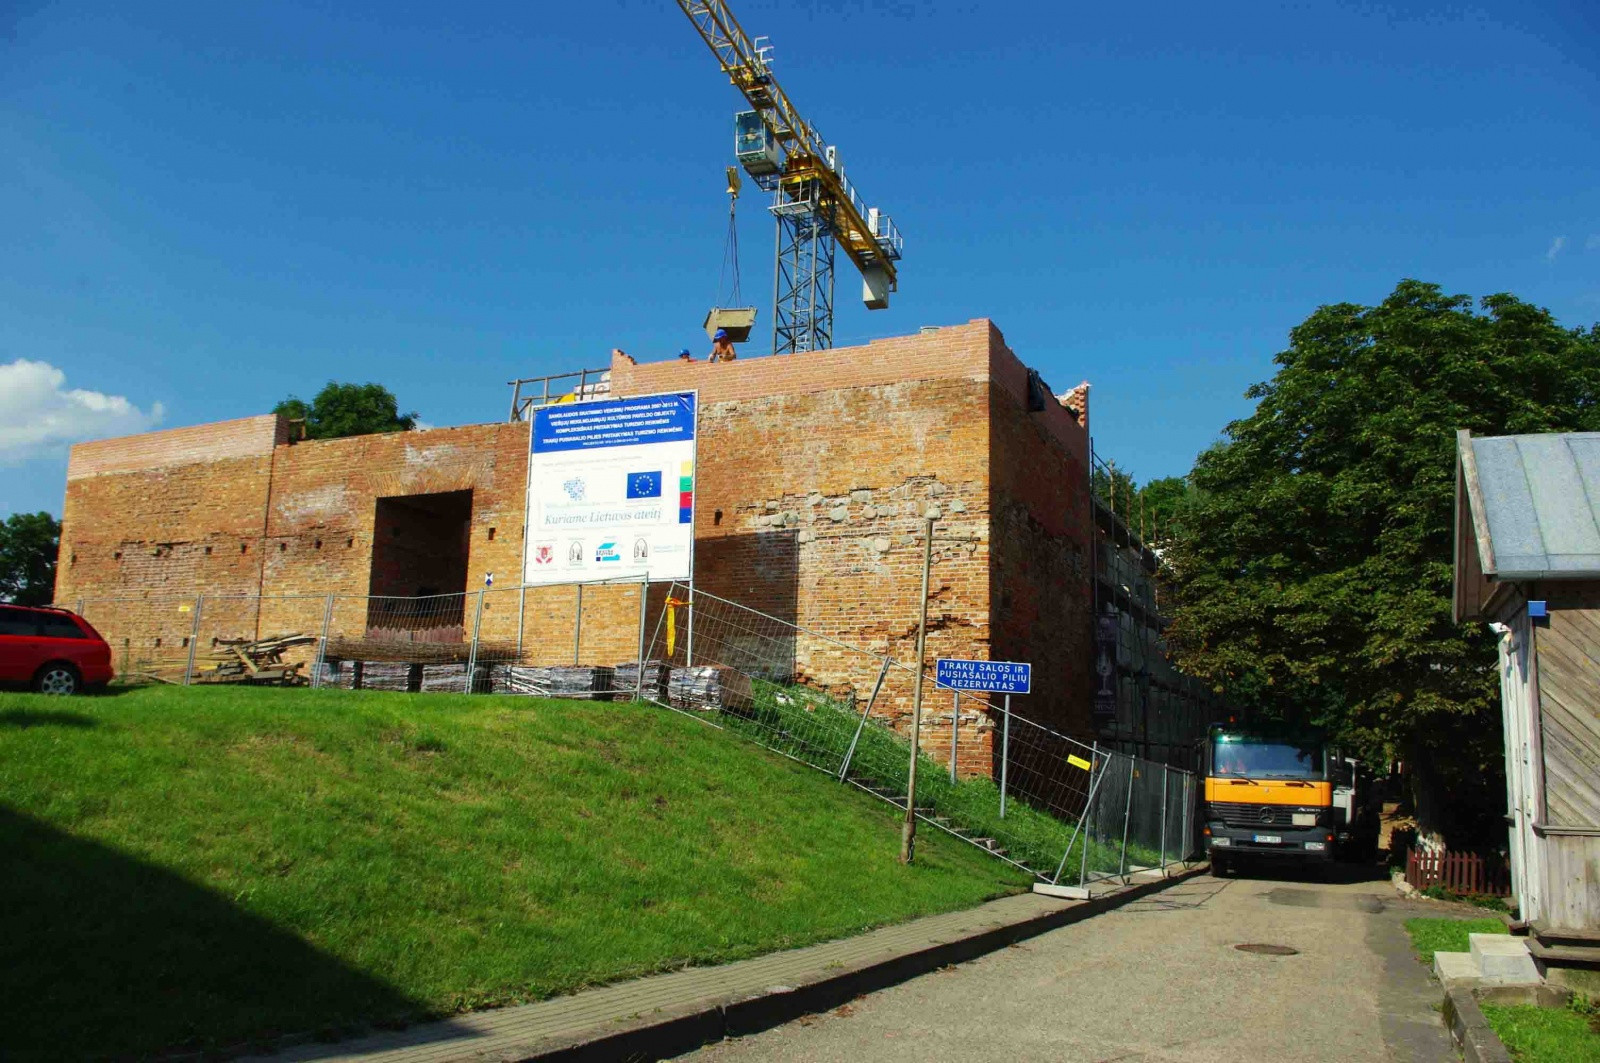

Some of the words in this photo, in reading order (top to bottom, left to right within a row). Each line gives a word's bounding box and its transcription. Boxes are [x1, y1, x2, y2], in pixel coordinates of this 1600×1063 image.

[545, 512, 587, 526] Kuriame
[589, 510, 632, 523] Lietuvos
[634, 508, 662, 520] ateitį
[944, 662, 975, 672] TRAKŲ
[979, 664, 1010, 673] SALOS
[940, 670, 996, 680] PUSIASALIO
[1002, 674, 1027, 684] PILIŲ
[951, 680, 1014, 690] REZERVATAS
